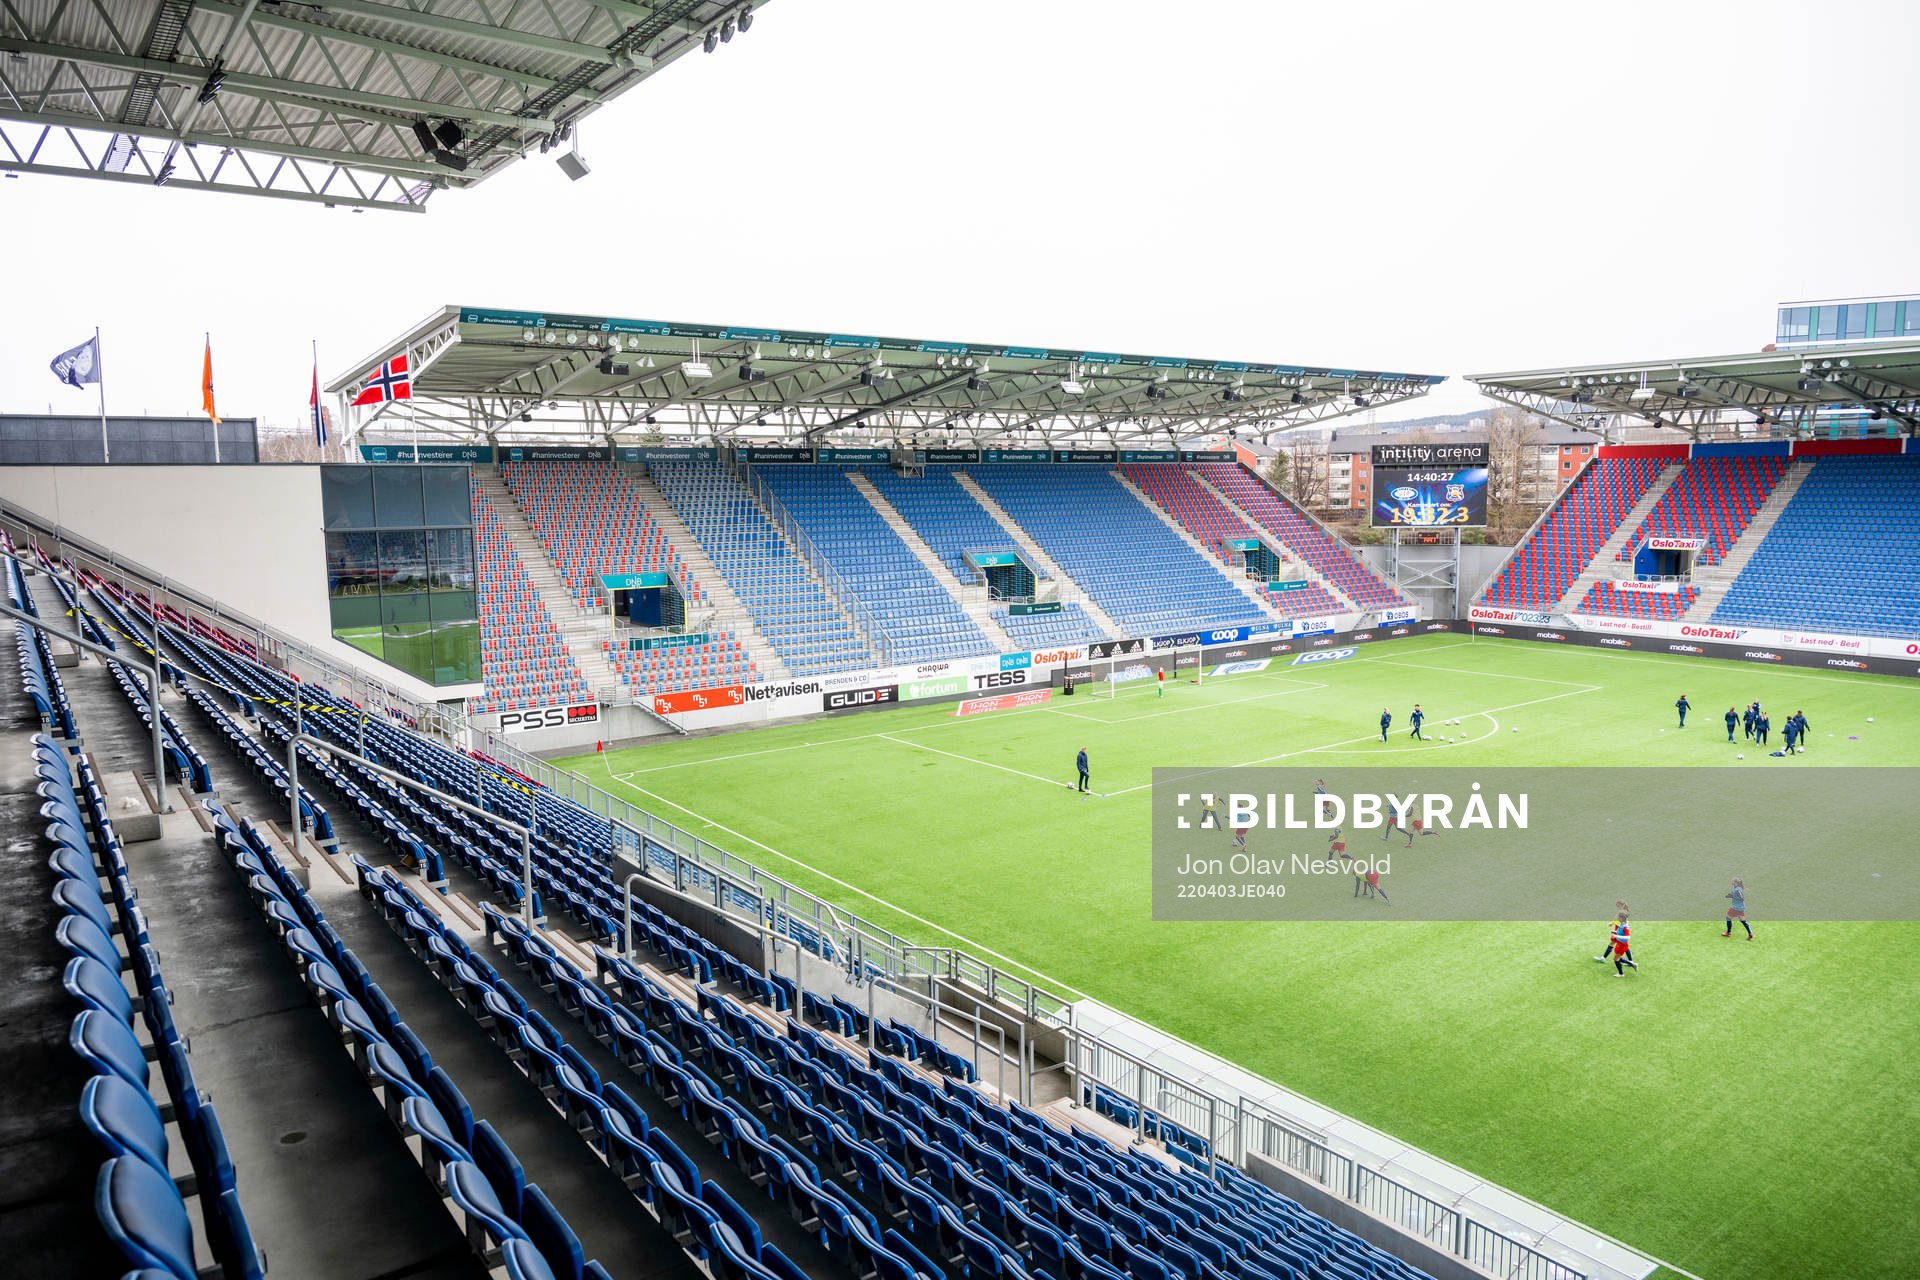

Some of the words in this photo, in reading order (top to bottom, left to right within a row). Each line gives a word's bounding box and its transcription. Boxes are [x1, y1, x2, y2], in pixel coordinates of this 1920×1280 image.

[397, 451, 454, 459] #hunnvesterer
[462, 450, 478, 460] DNB
[1381, 446, 1431, 461] intility
[1437, 447, 1482, 458] arena
[1407, 472, 1454, 482] 14:40:27
[1651, 539, 1695, 549] OsloTaxi
[625, 575, 643, 588] DNB
[1622, 581, 1654, 589] OsloTaxi
[1394, 611, 1409, 619] OBOS
[1471, 608, 1514, 620] OsloTaxi
[1310, 621, 1327, 630] OBOS
[1211, 629, 1239, 641] coop
[1680, 626, 1736, 640] OsloTaxi
[1906, 643, 1920, 655] O
[1033, 650, 1079, 664] OsloTaxi
[1302, 649, 1355, 663] coop
[825, 677, 851, 686] BRENDEN
[974, 670, 1026, 689] TESS
[745, 681, 823, 703] Nettavisen.
[918, 682, 958, 699] fortum
[831, 688, 889, 707] GUIDE
[500, 708, 564, 732] PSS
[568, 715, 597, 724] SECURITAS
